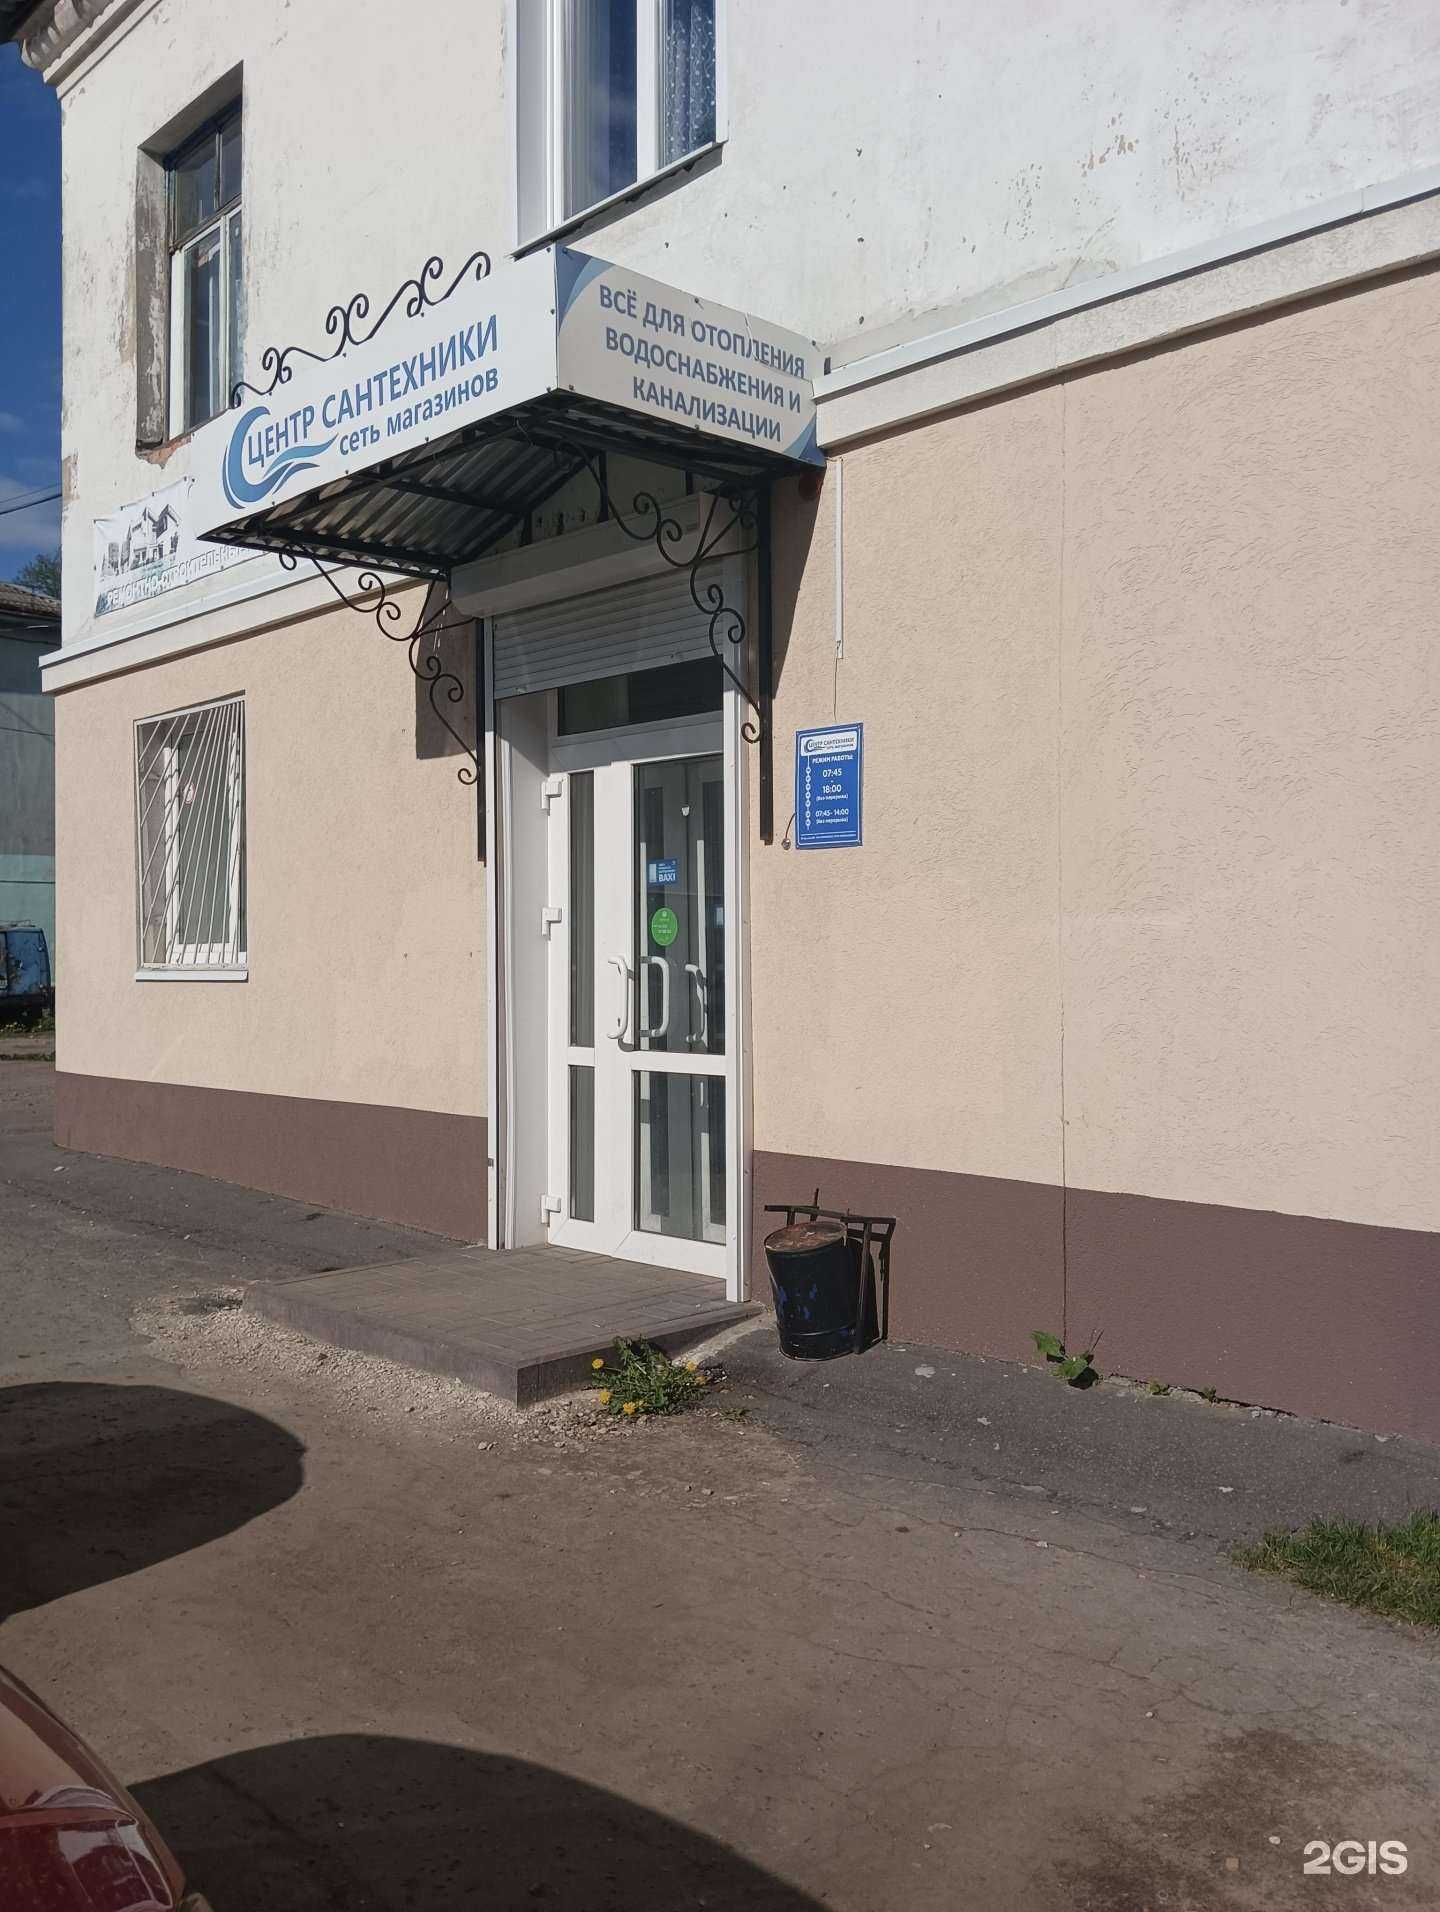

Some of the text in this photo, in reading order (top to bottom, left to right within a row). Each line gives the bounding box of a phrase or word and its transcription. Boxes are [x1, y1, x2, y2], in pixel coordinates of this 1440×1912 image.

[599, 284, 805, 379] ВСЁ ДЛЯ ОТОПЛЕНИЯ
[605, 326, 801, 413] ВОДОСНАБЖЕНИЯ И
[248, 314, 498, 467] ЦЕНТР САНТЕХНИКИ
[632, 376, 781, 442] КАНАЛИЗАЦИИ
[340, 368, 499, 456] сеть магазинов
[822, 768, 842, 778] 07:45
[831, 754, 853, 762] РАБОТЫ
[822, 785, 842, 794] 18:00
[834, 808, 849, 816] 14:00
[658, 872, 676, 882] BAXI
